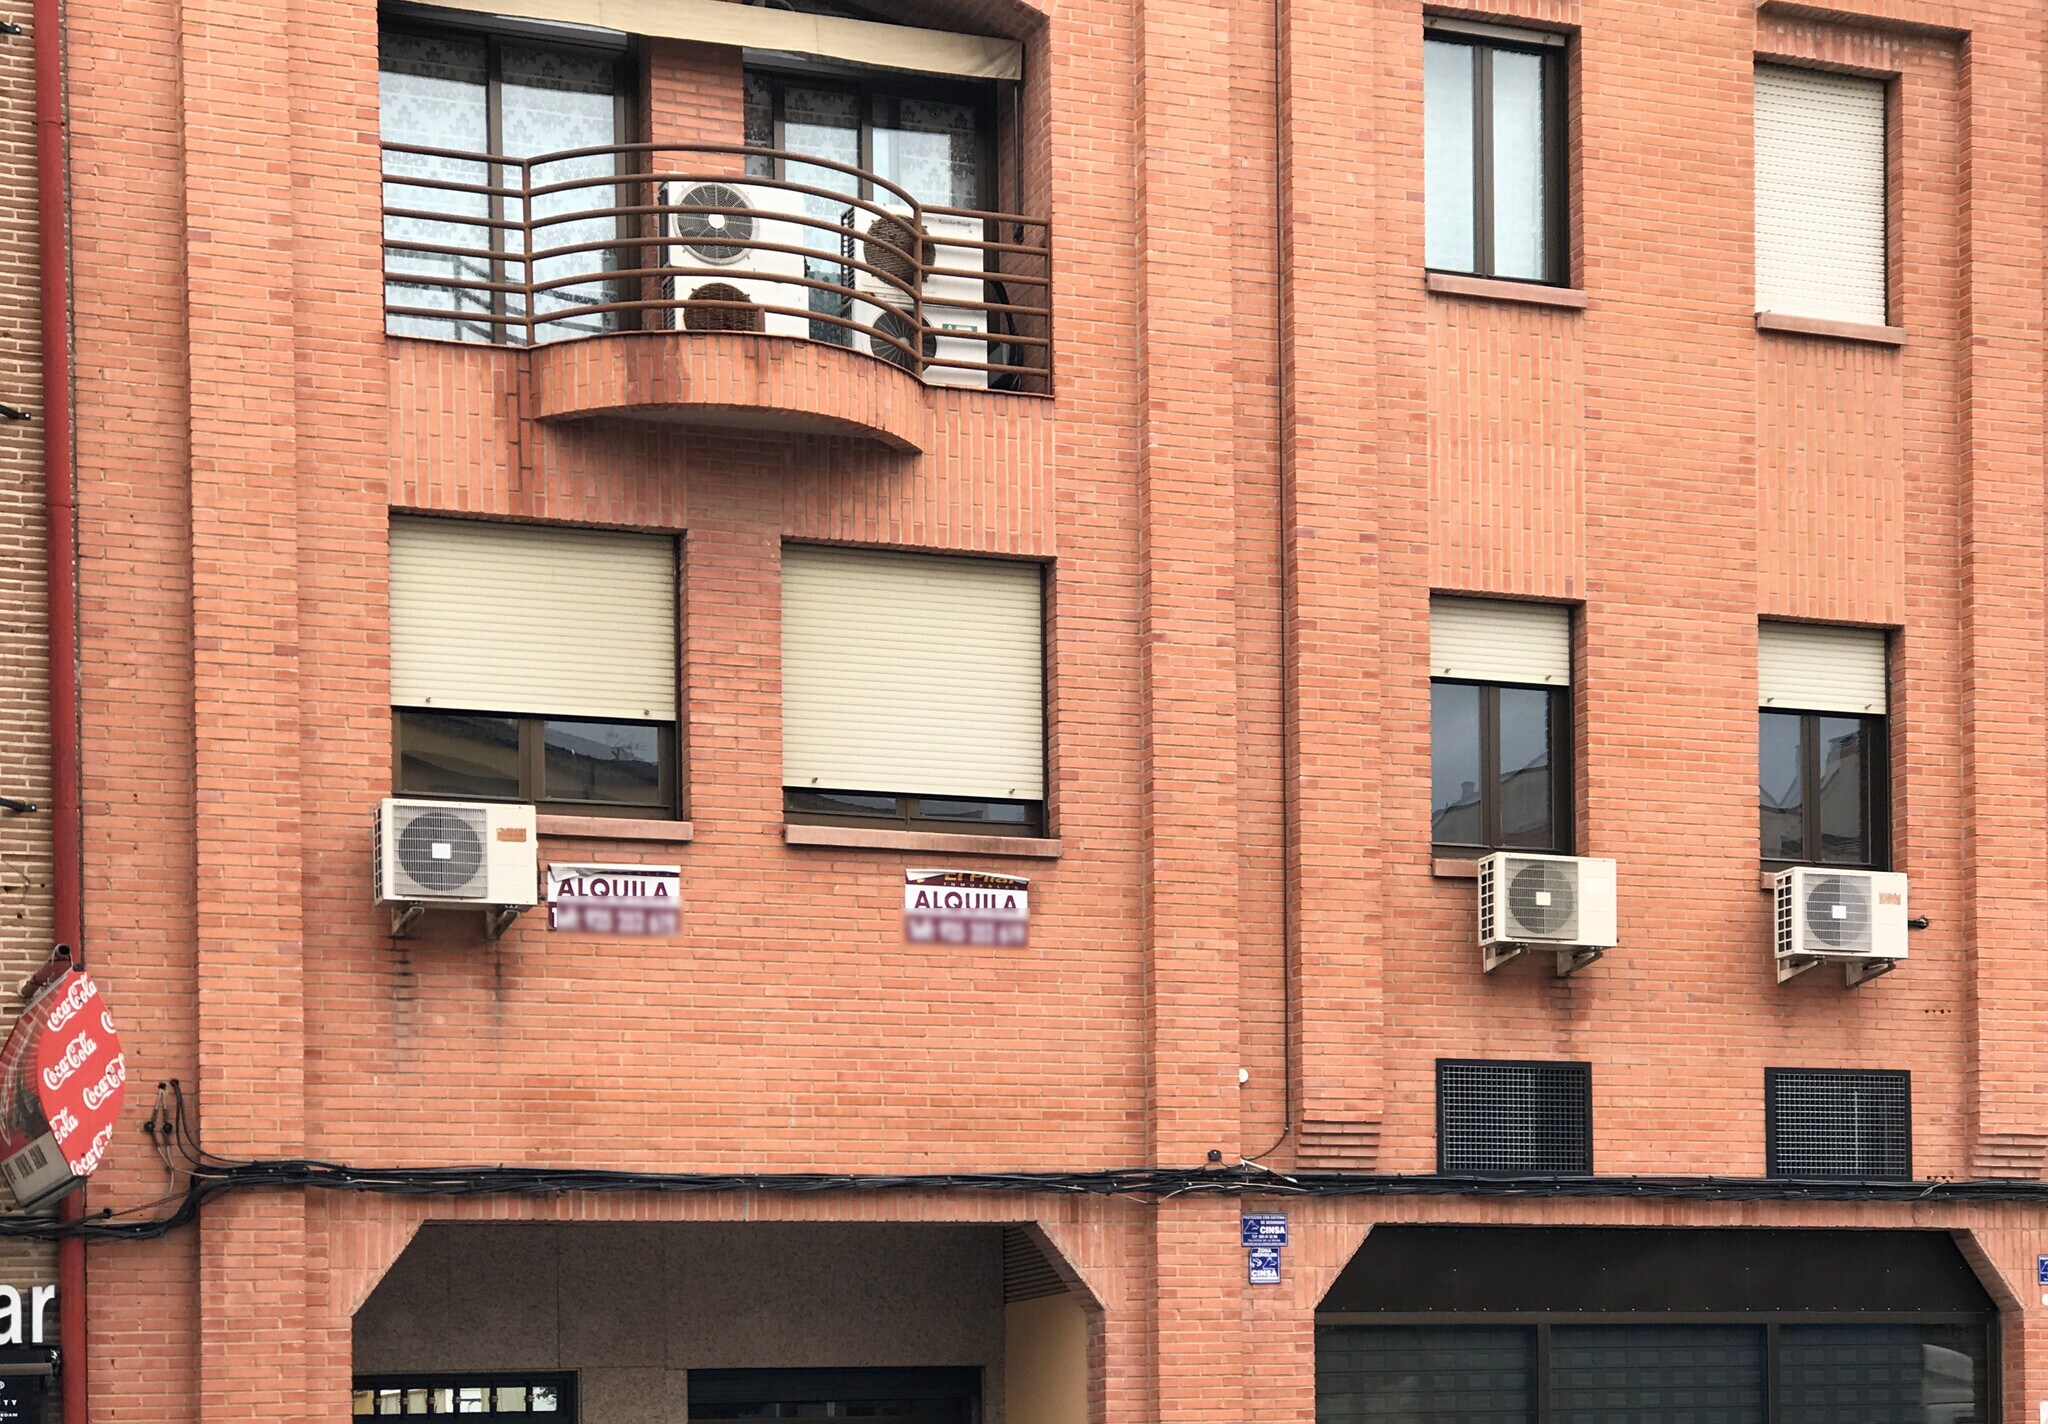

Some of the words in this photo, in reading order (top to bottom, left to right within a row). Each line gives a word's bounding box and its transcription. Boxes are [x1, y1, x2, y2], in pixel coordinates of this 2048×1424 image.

[557, 878, 669, 897] ALQUILA
[914, 890, 1017, 909] ALQUILA
[1260, 1226, 1285, 1234] CINSA
[1251, 1269, 1277, 1277] CINSA
